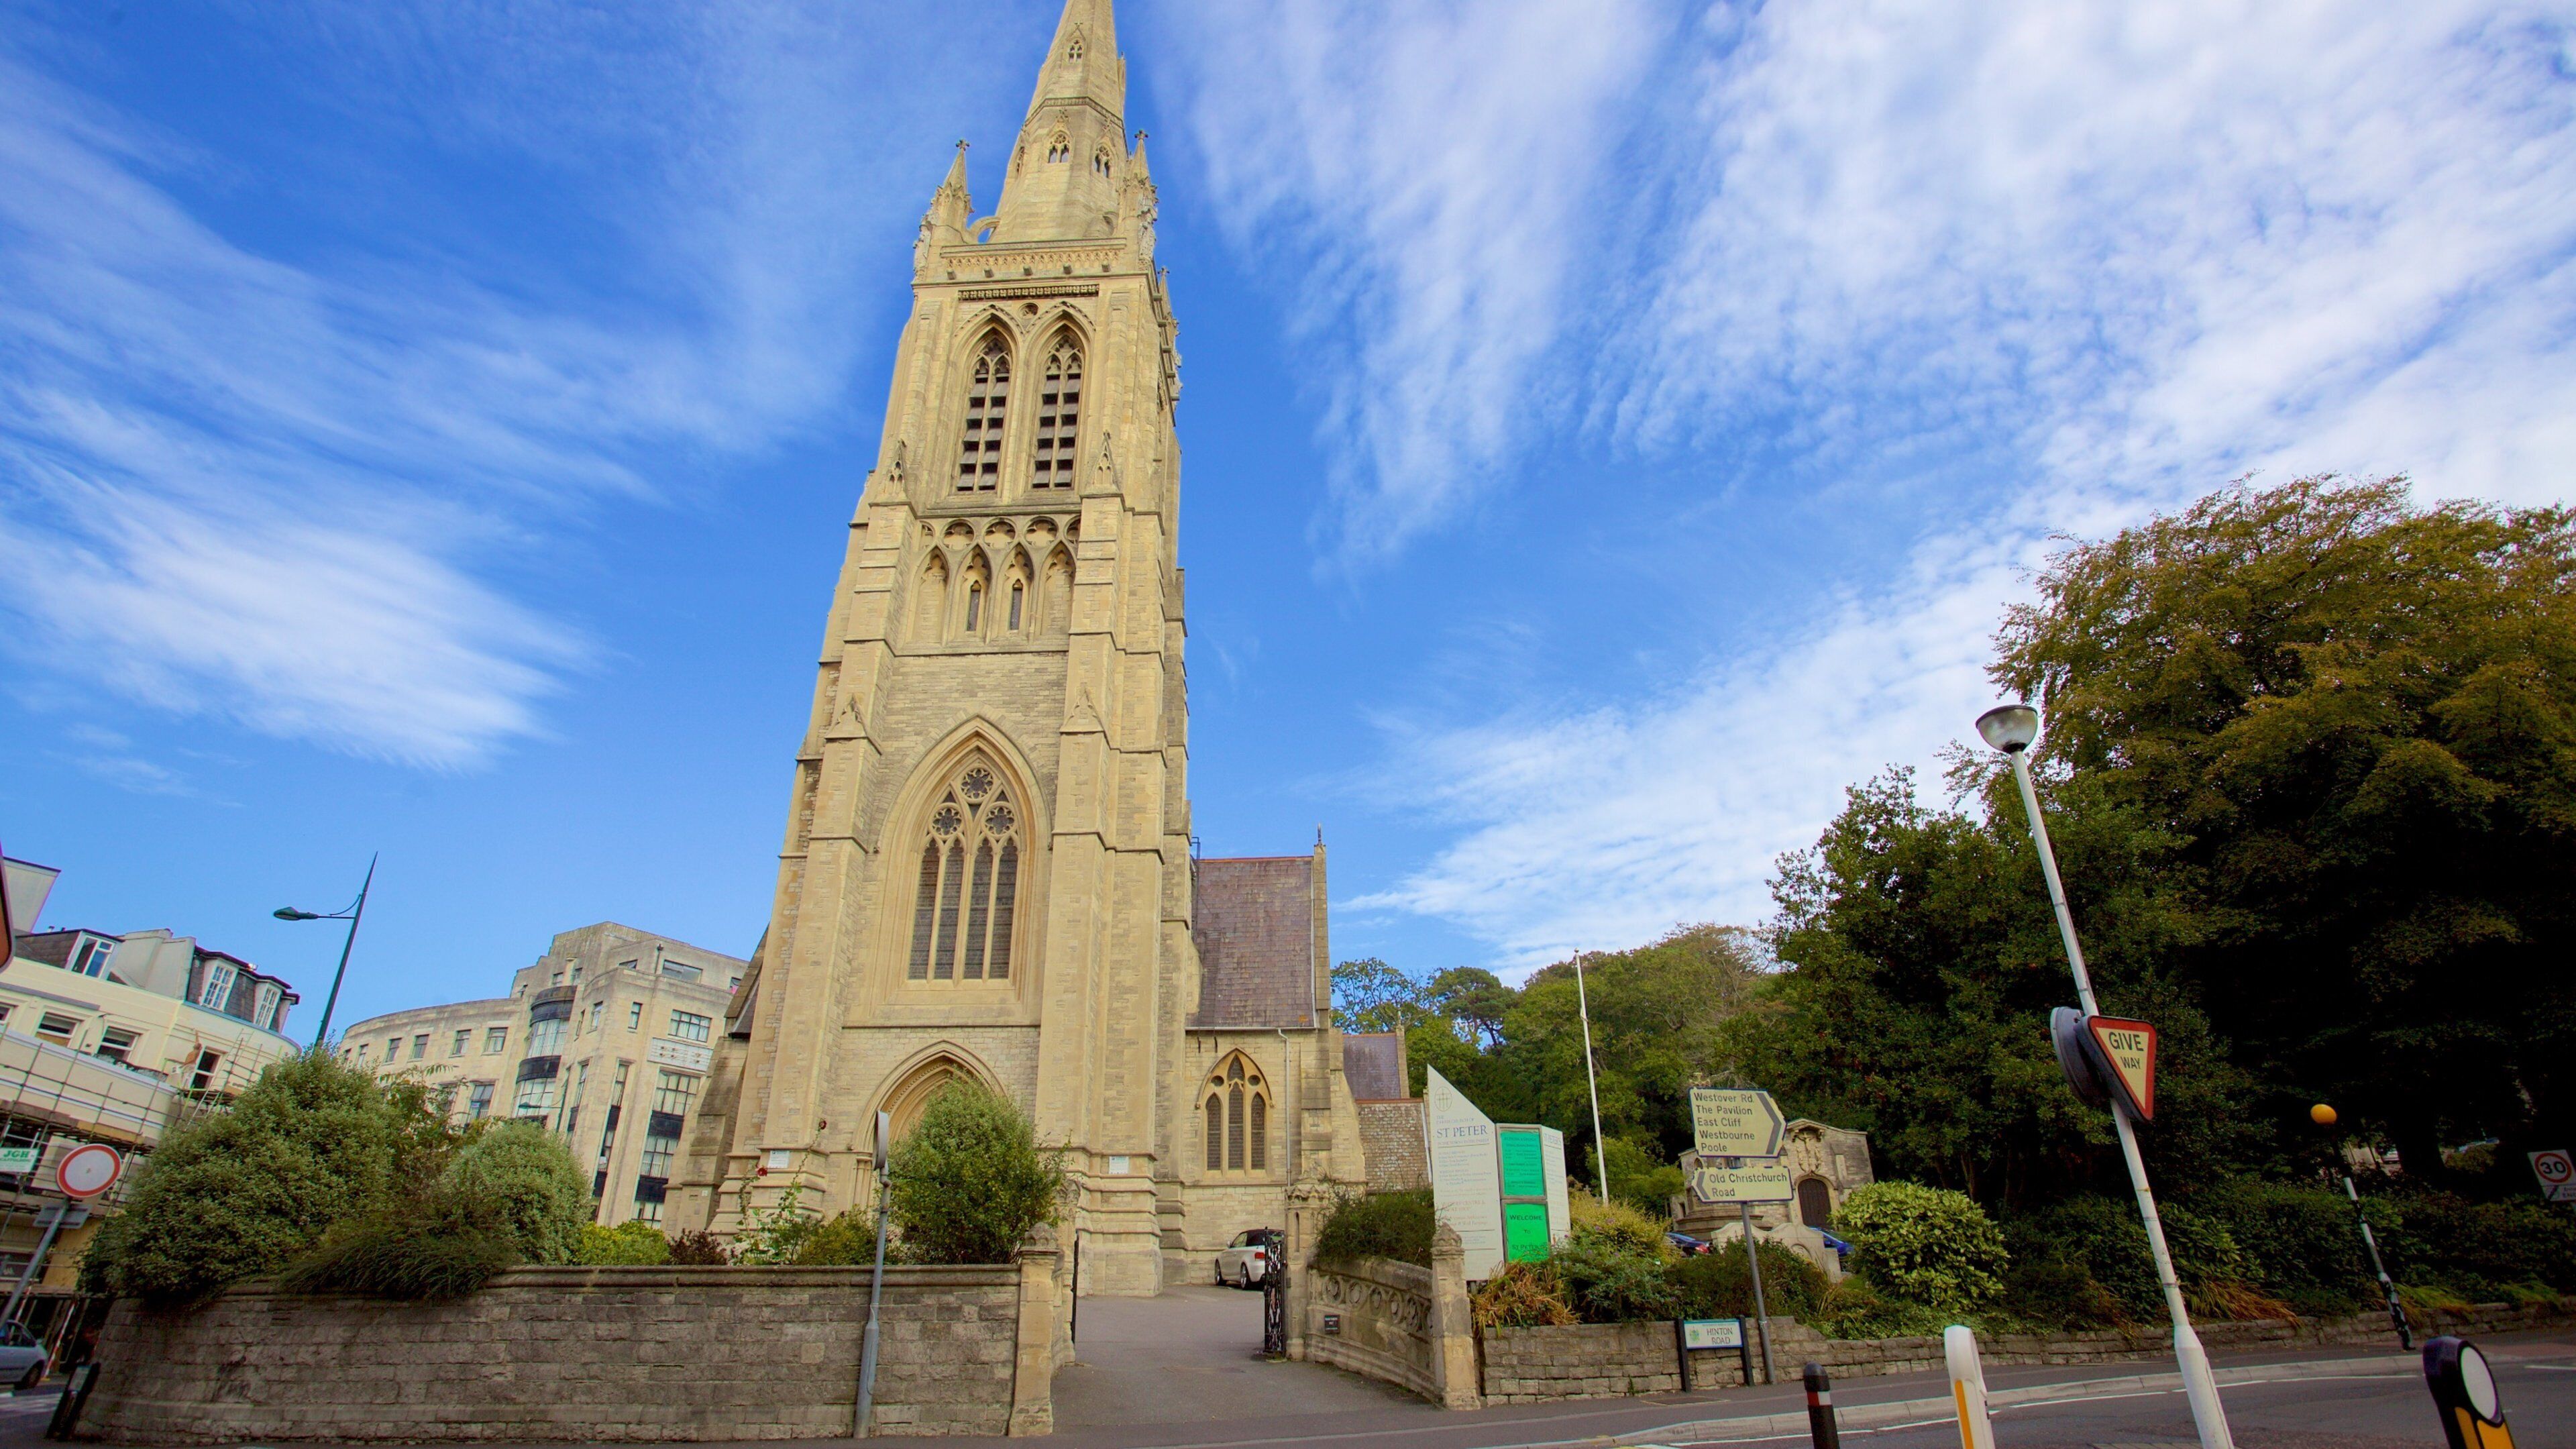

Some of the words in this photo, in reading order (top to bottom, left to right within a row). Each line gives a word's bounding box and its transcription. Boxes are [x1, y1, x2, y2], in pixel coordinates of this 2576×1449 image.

[2109, 1032, 2144, 1051] GIVE
[2121, 1057, 2141, 1069] WAY
[1694, 1093, 1736, 1102] Westover
[1696, 1105, 1713, 1114] The
[1717, 1106, 1753, 1115] Pavilion
[1697, 1118, 1718, 1126] East
[1721, 1118, 1741, 1127] Cliff
[1436, 1128, 1450, 1138] ST
[1453, 1125, 1488, 1137] PETER
[1699, 1130, 1755, 1140] Westbourne
[1701, 1142, 1727, 1152] Poole
[2540, 1161, 2566, 1174] 30
[1709, 1174, 1725, 1183] Old
[1729, 1173, 1787, 1183] Christchurch
[1712, 1188, 1735, 1197] Road
[1706, 1328, 1733, 1336] HINTON
